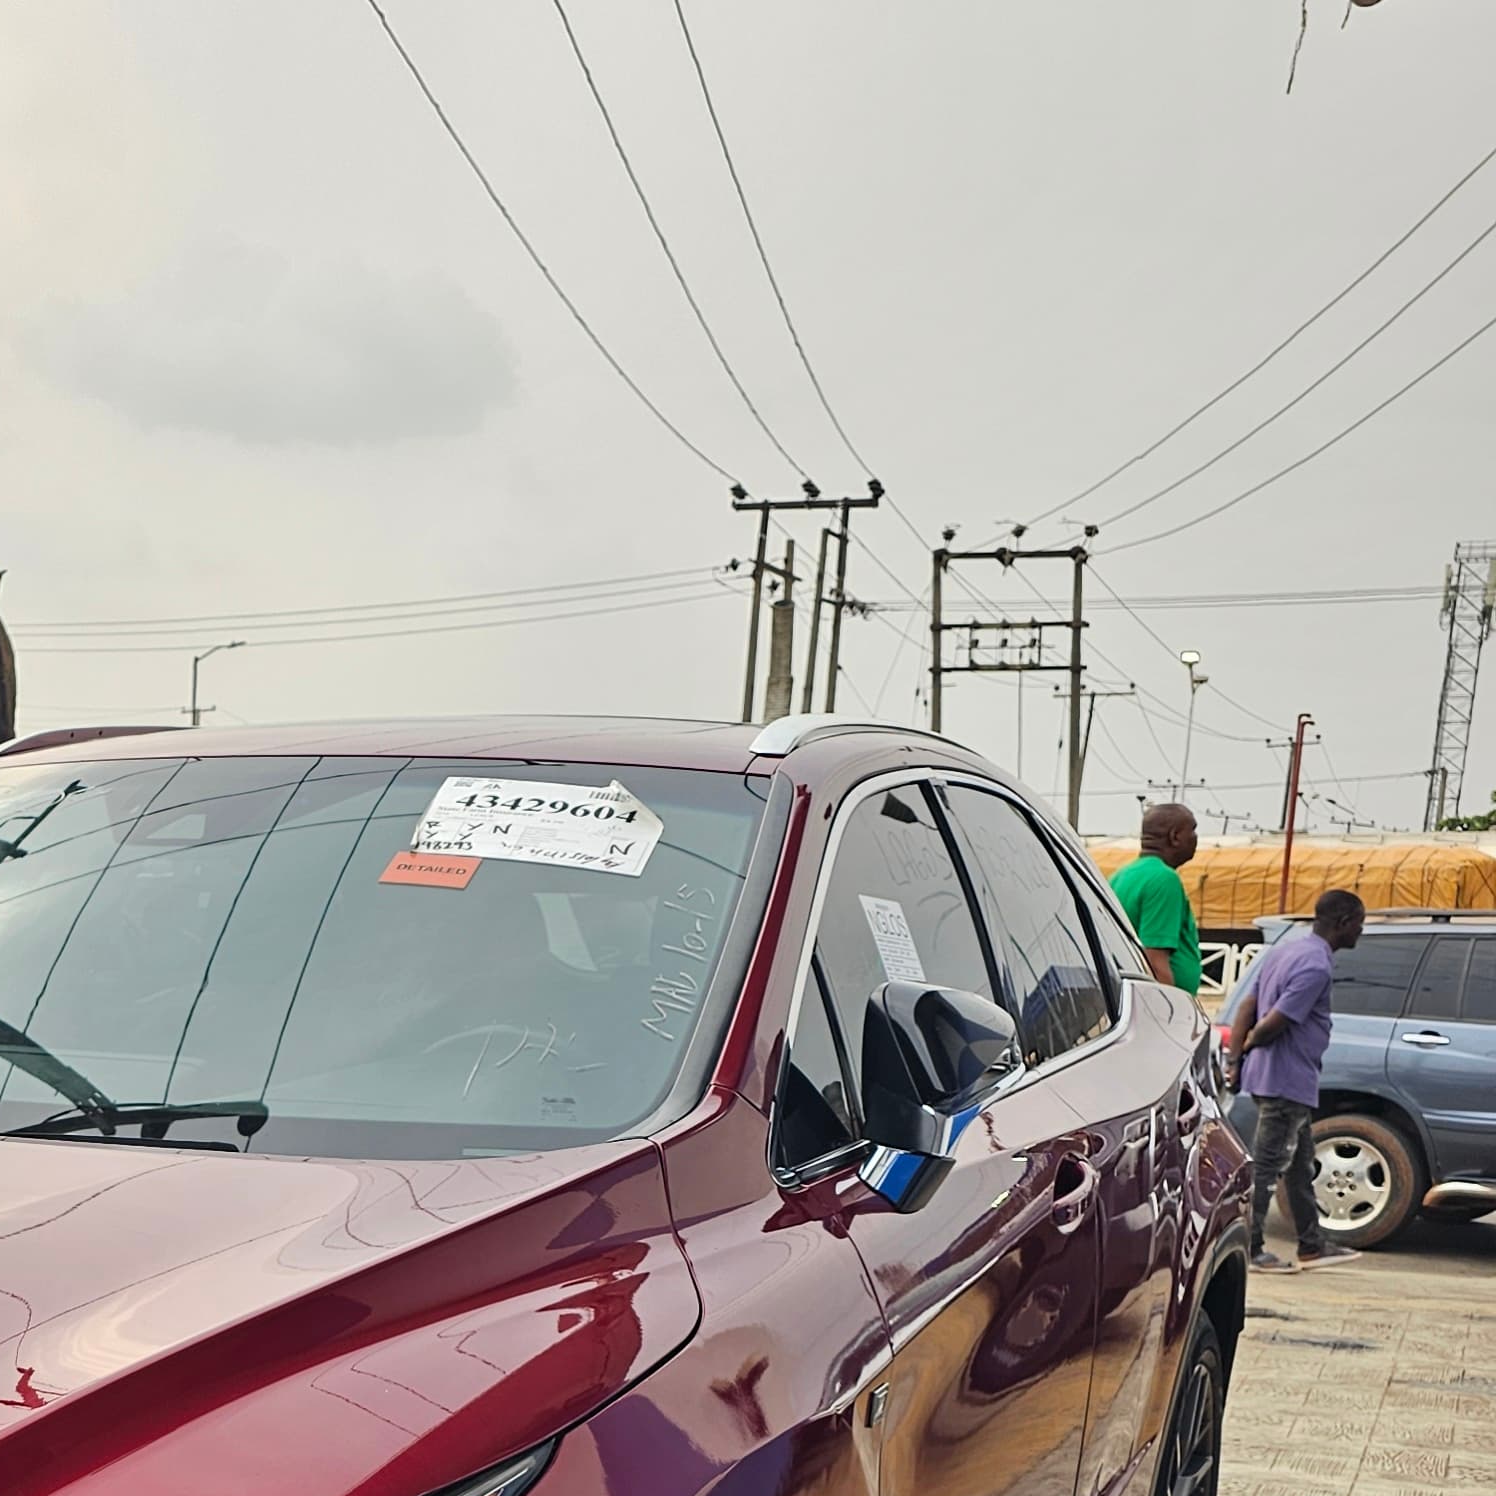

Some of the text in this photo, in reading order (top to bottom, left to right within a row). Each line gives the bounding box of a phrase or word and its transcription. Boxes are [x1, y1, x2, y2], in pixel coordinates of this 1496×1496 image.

[455, 793, 639, 824] 43429604
[609, 841, 636, 856] N
[395, 863, 467, 876] DETAILED
